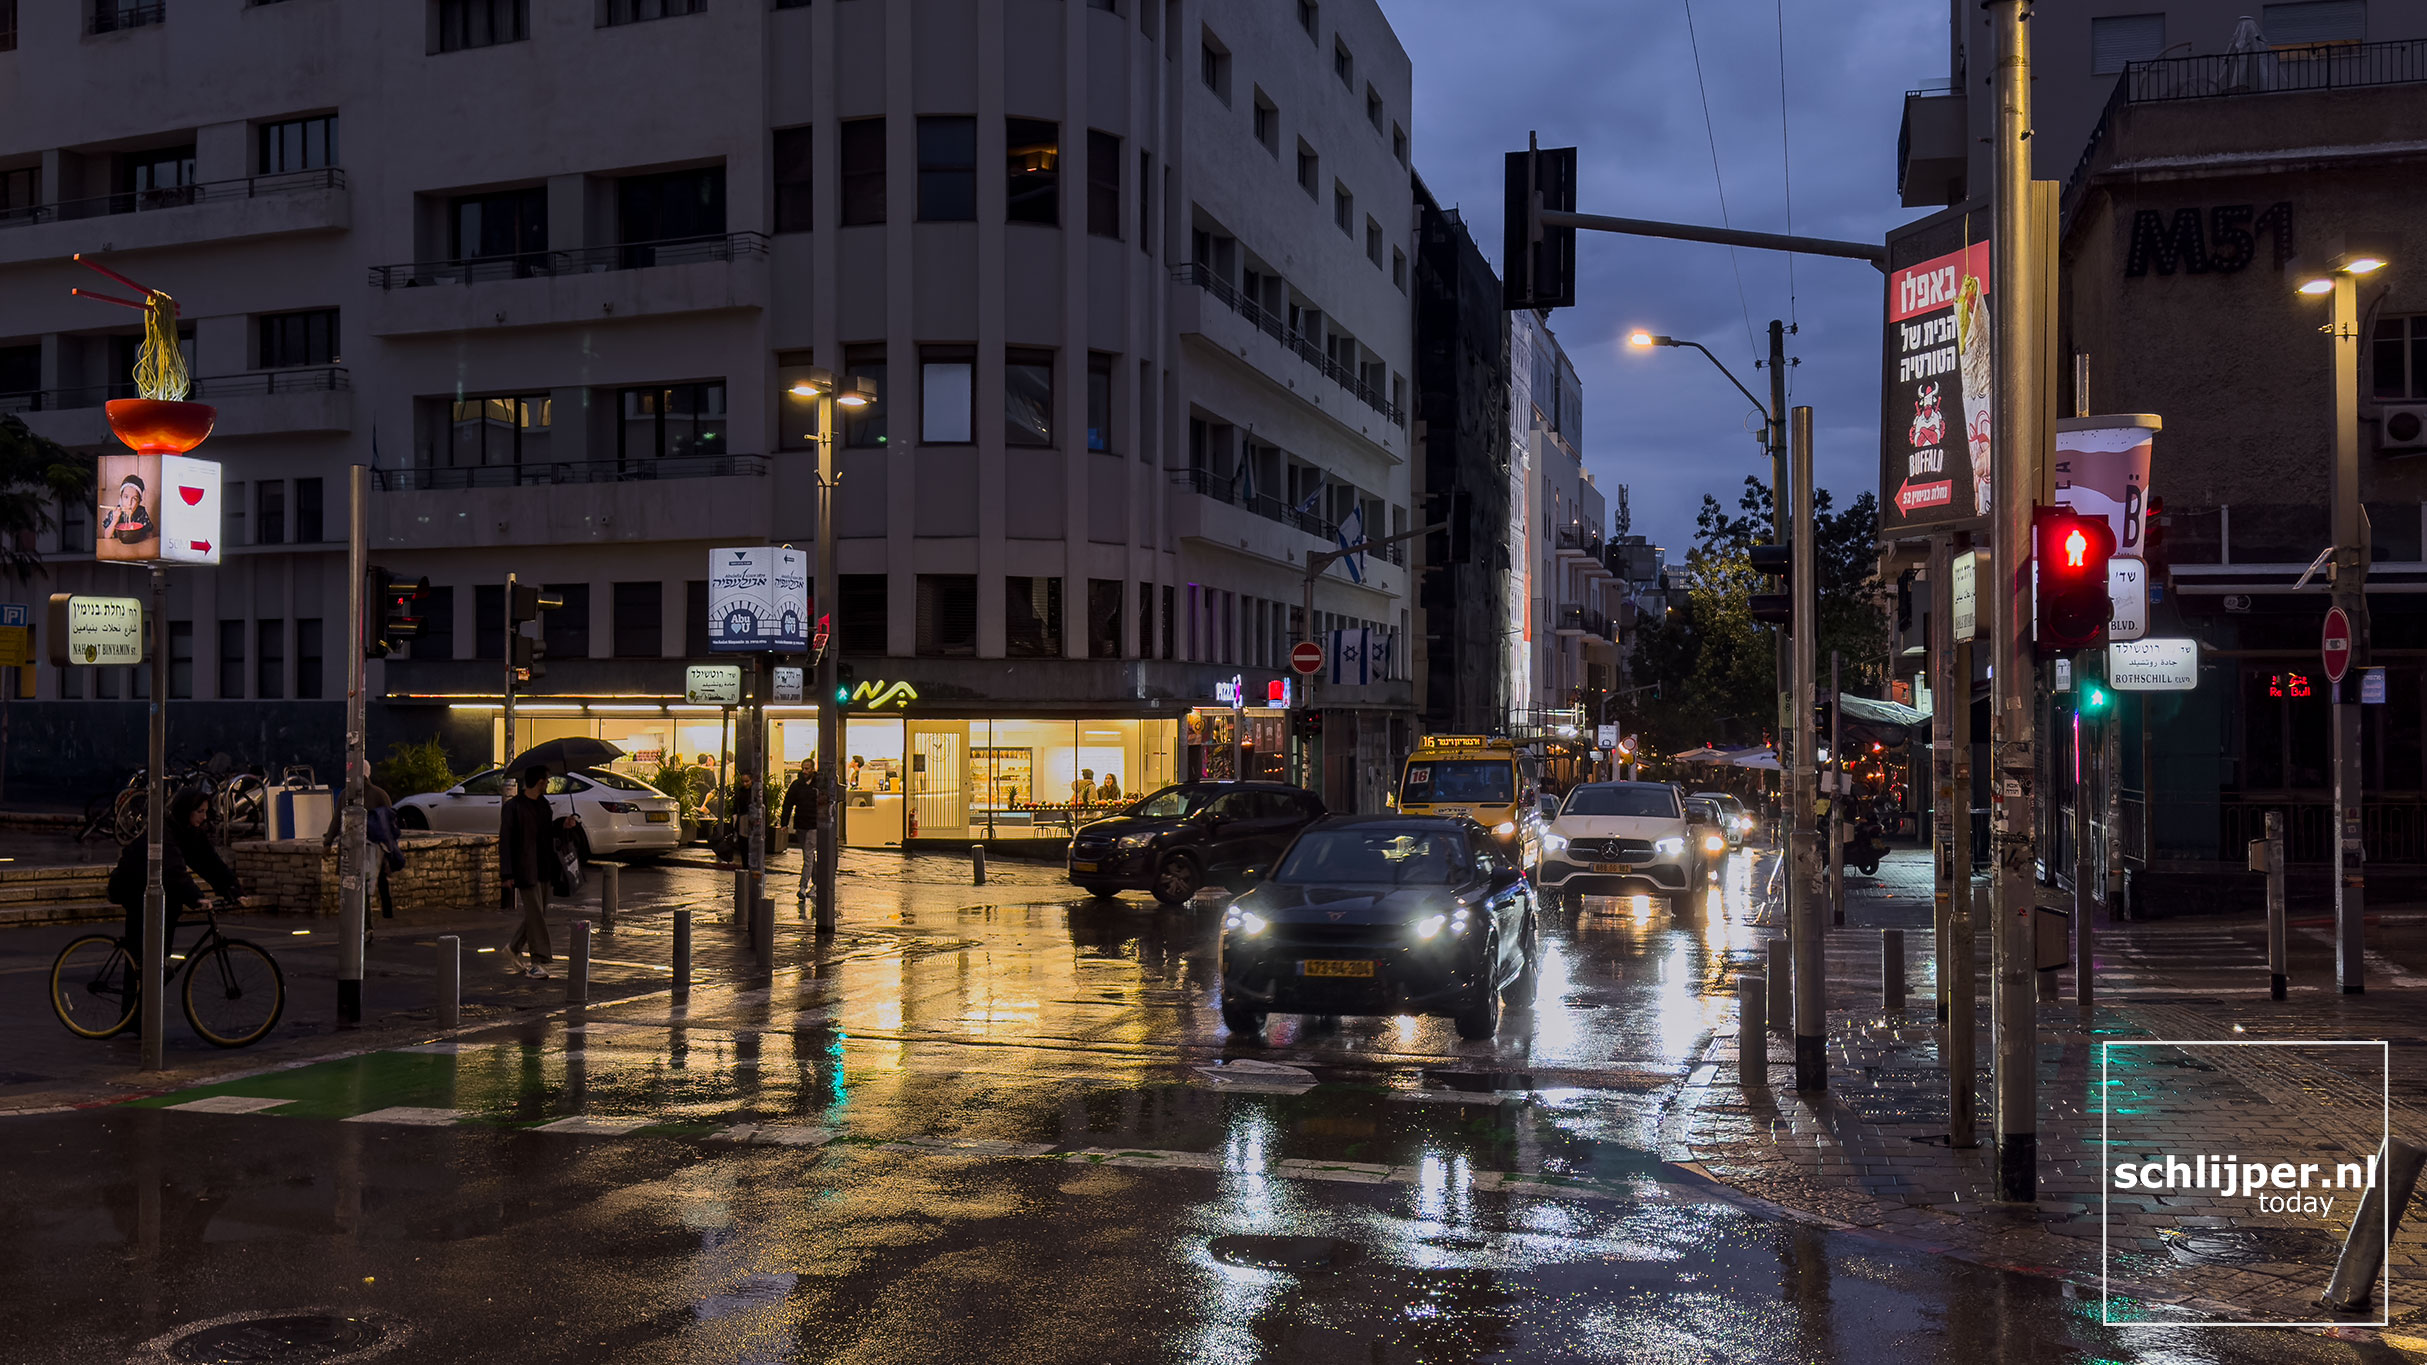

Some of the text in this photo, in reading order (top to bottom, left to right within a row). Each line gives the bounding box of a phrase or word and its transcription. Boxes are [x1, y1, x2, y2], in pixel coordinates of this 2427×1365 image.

[2124, 201, 2293, 278] M51
[1901, 265, 1956, 314] באפלו
[1901, 314, 1957, 353] הבית של
[1900, 345, 1956, 383] הטורטיה
[1909, 448, 1944, 477] BUFFALO
[73, 603, 101, 619] בנימין
[104, 602, 125, 616] נחלת
[731, 613, 751, 624] Abu
[784, 614, 796, 624] Abu
[2111, 620, 2138, 631] BLVD.
[102, 643, 130, 656] BINYAMIN
[2115, 643, 2160, 654] רוטשילד
[691, 669, 724, 679] רוטשילד
[2291, 686, 2311, 697] Bull
[1423, 736, 1435, 748] 16
